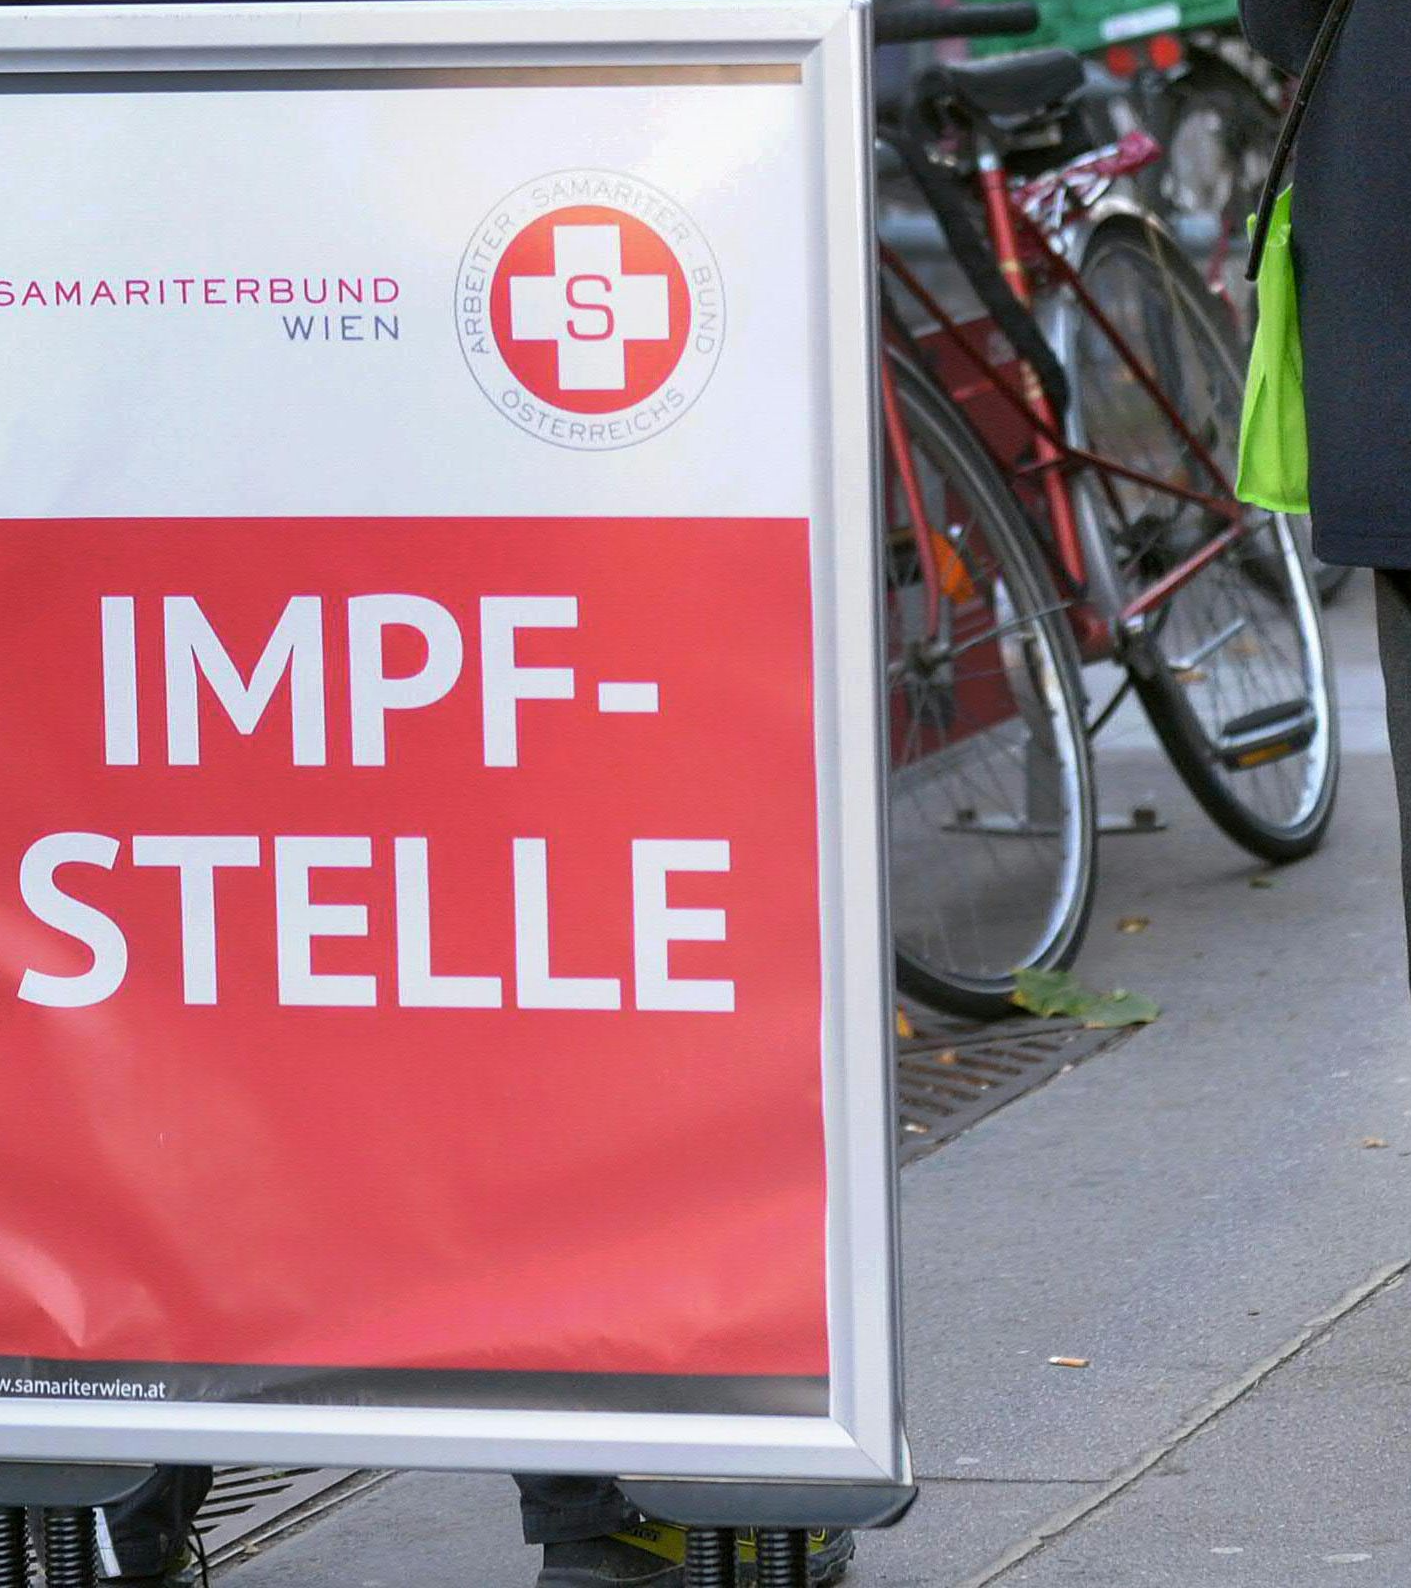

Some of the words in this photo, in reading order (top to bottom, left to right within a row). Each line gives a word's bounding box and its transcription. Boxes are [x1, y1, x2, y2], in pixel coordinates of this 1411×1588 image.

[463, 211, 513, 356] ARBEITER
[531, 176, 691, 246] SAMARITER
[691, 265, 717, 355] BUND
[564, 273, 615, 342] S
[281, 314, 401, 342] WIEN
[500, 386, 686, 444] ÖSTERREICHS
[99, 593, 659, 768] IMPF-
[16, 830, 737, 1012] STELLE
